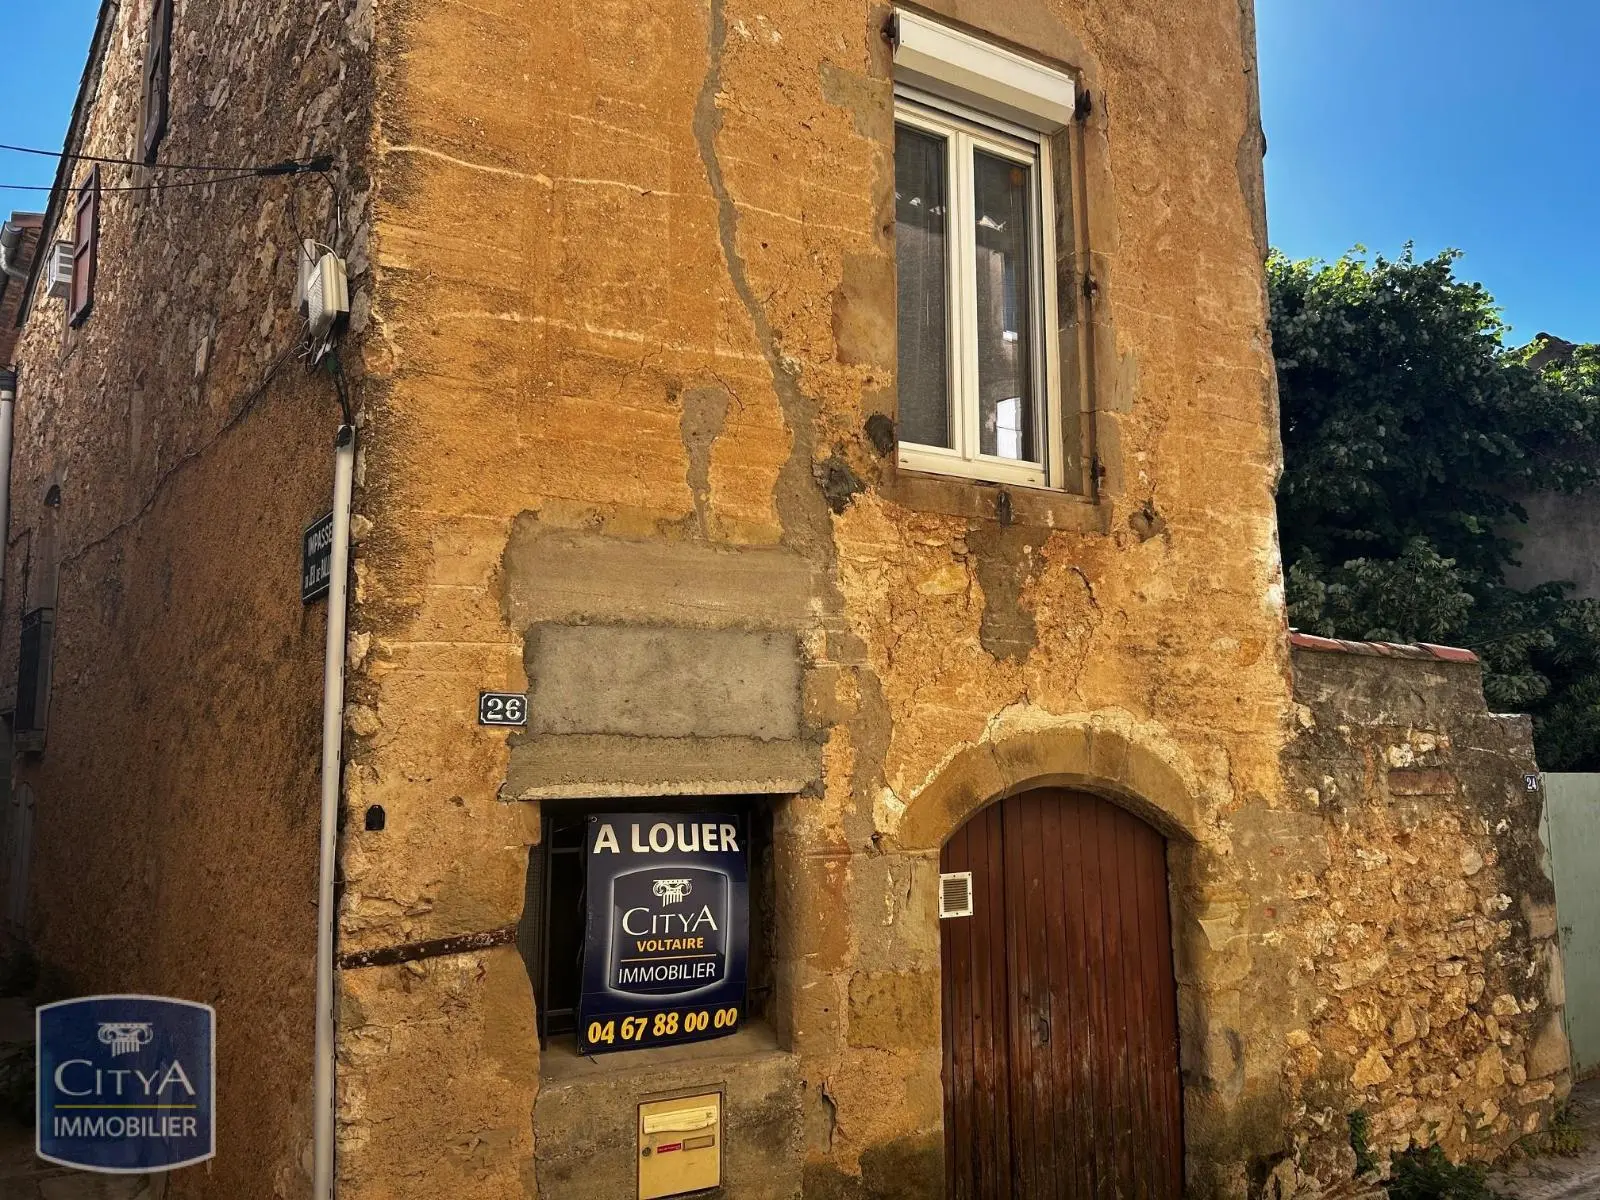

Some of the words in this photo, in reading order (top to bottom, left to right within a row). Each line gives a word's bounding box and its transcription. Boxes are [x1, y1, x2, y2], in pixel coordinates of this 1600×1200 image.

[308, 522, 333, 556] IMPASSE
[487, 698, 521, 720] 26
[1527, 777, 1537, 790] 24
[593, 823, 620, 853] A
[631, 822, 740, 853] LOUER
[636, 937, 704, 952] VOLTAIRE
[618, 962, 716, 984] IMMOBILIER
[588, 1021, 615, 1044] 04
[621, 1016, 648, 1041] 67
[653, 1012, 678, 1037] 88
[684, 1010, 709, 1033] 00
[714, 1007, 738, 1027] 00
